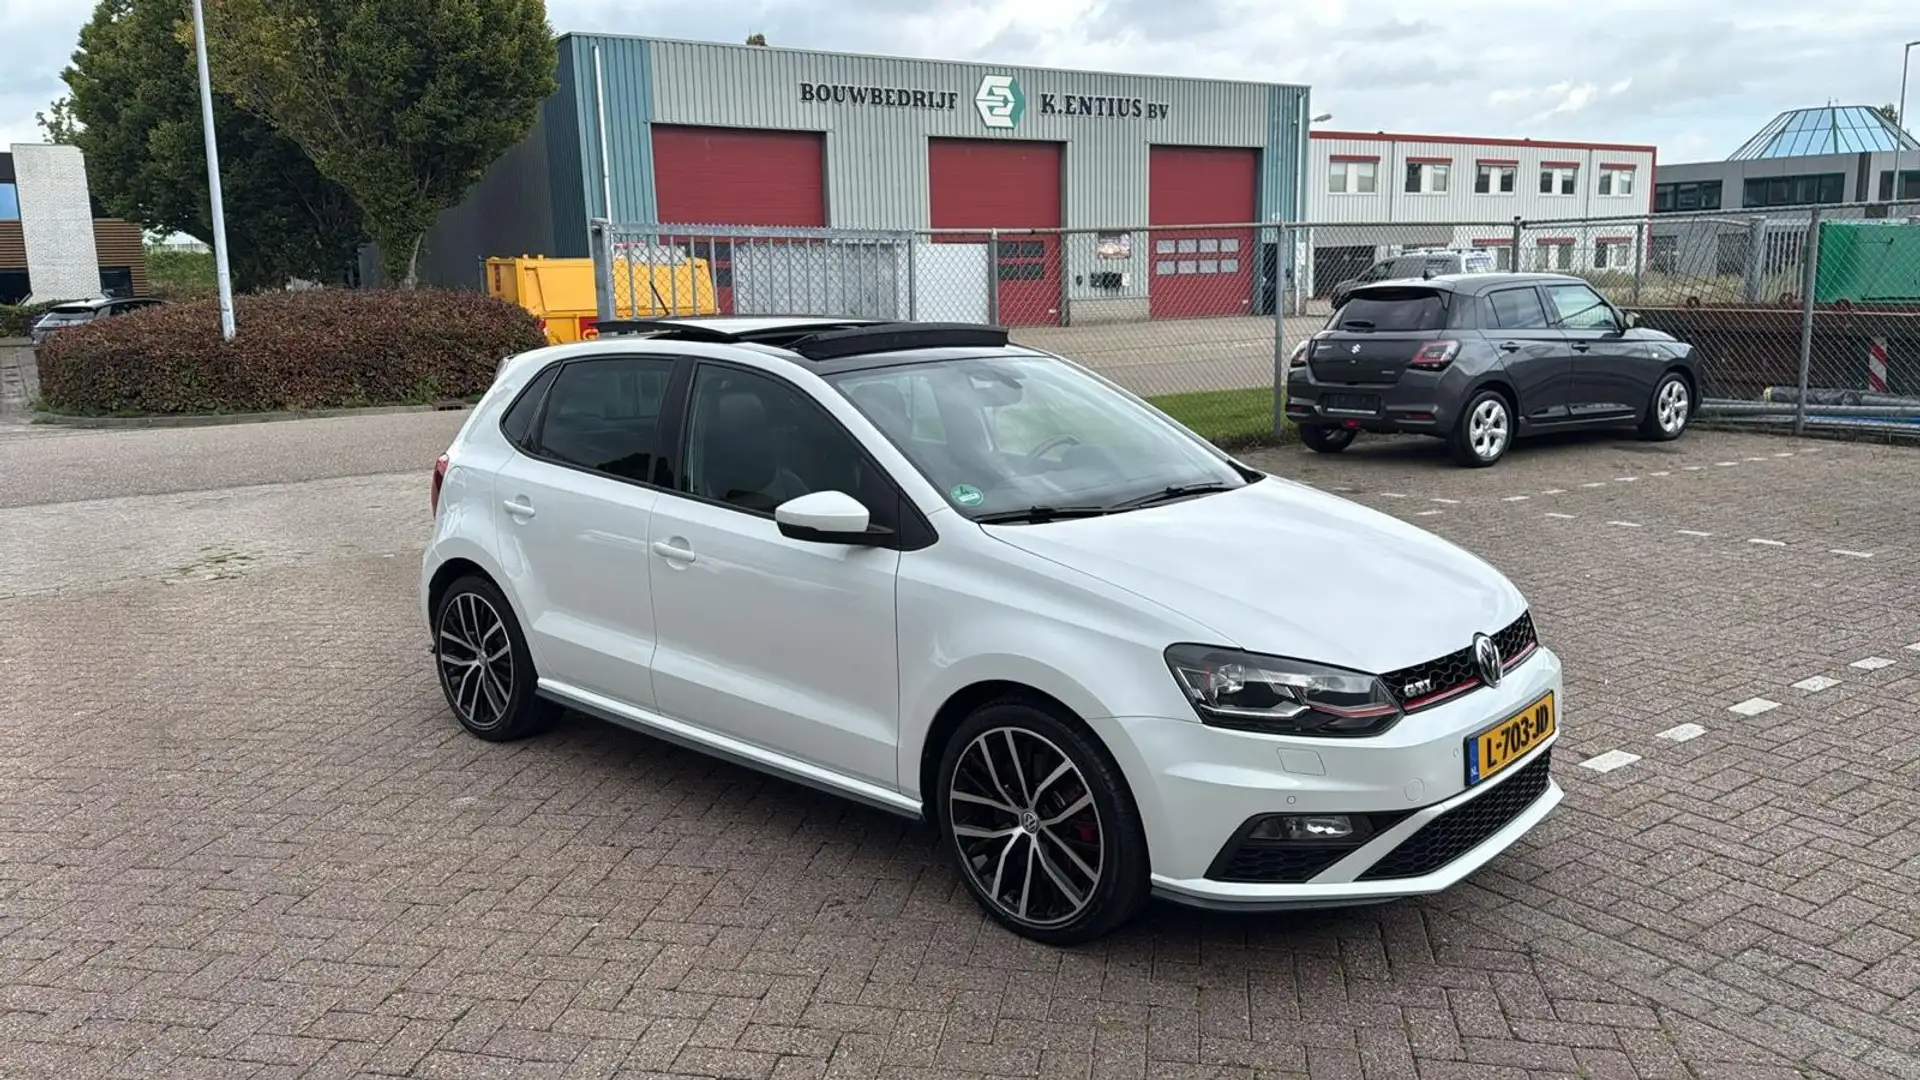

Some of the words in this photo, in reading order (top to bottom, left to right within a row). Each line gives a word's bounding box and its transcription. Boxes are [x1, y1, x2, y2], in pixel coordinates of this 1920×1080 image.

[800, 83, 958, 109] BOUWBEDRIJF
[1041, 93, 1142, 118] K.ENTIUS
[1147, 103, 1169, 120] BV
[1403, 679, 1431, 698] GTI
[1486, 704, 1549, 769] L-703-JD
